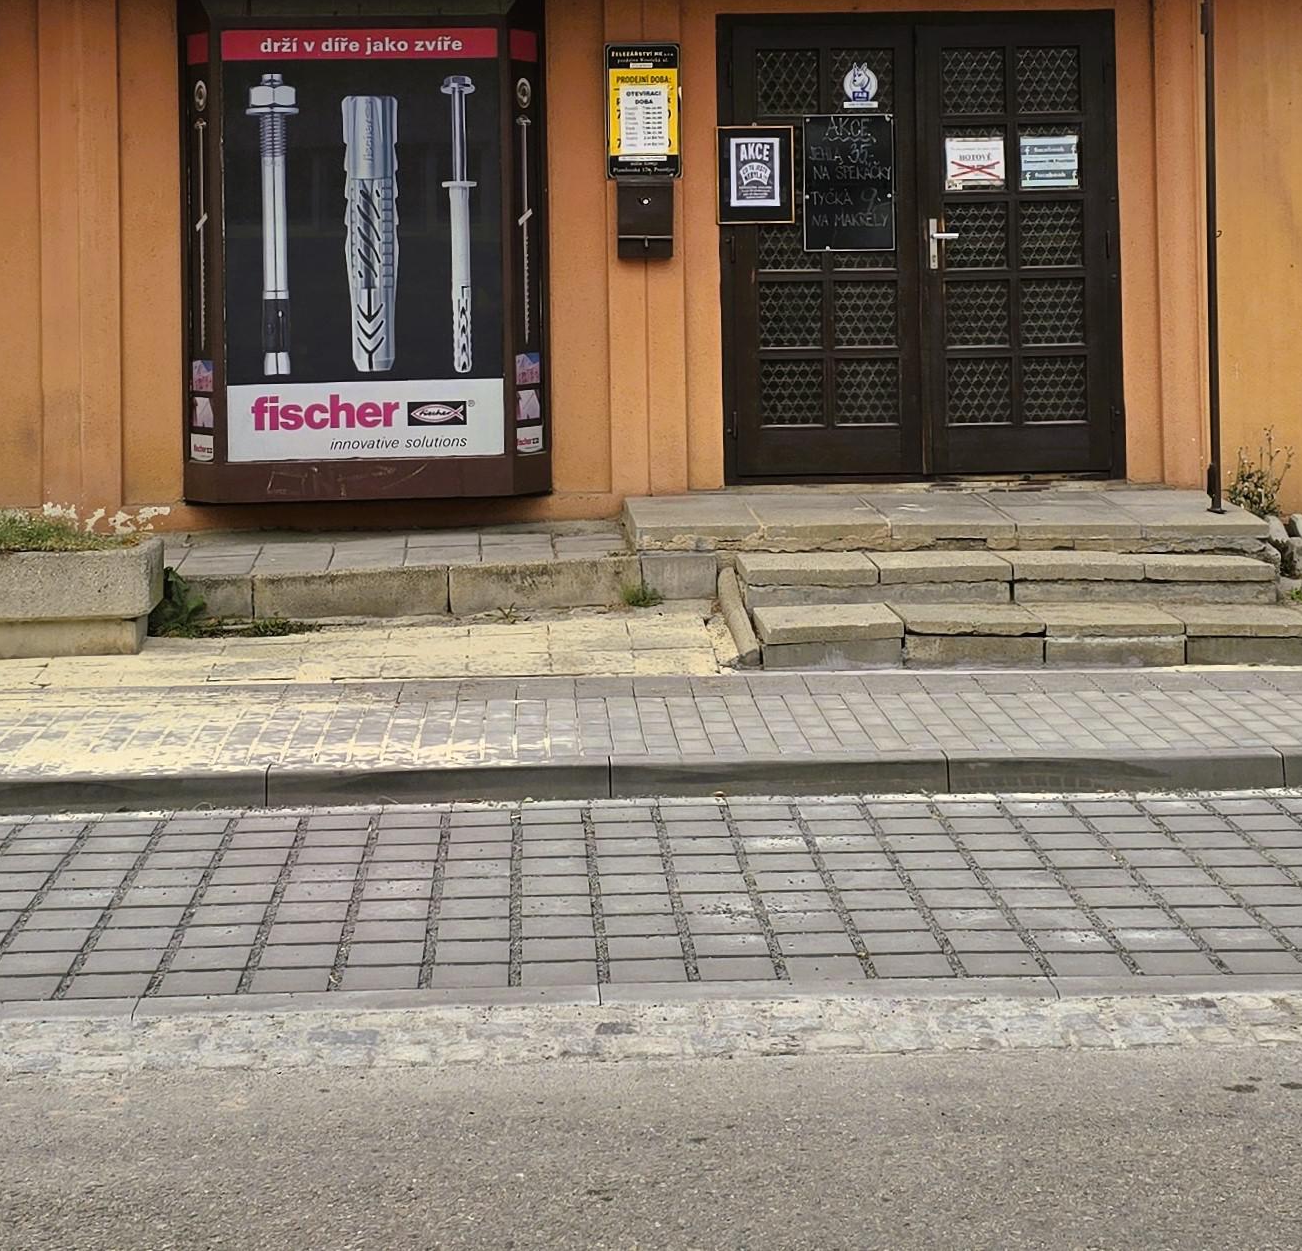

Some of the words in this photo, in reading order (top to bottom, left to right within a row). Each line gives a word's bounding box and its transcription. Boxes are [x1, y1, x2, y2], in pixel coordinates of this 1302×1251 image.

[260, 38, 297, 53] drží
[303, 41, 315, 52] v
[321, 38, 360, 52] díře
[365, 37, 409, 55] jako
[414, 36, 463, 52] zvíře
[740, 143, 770, 161] AKCE
[251, 394, 399, 431] fischer
[330, 437, 399, 451] innovative
[405, 435, 467, 449] solutions
